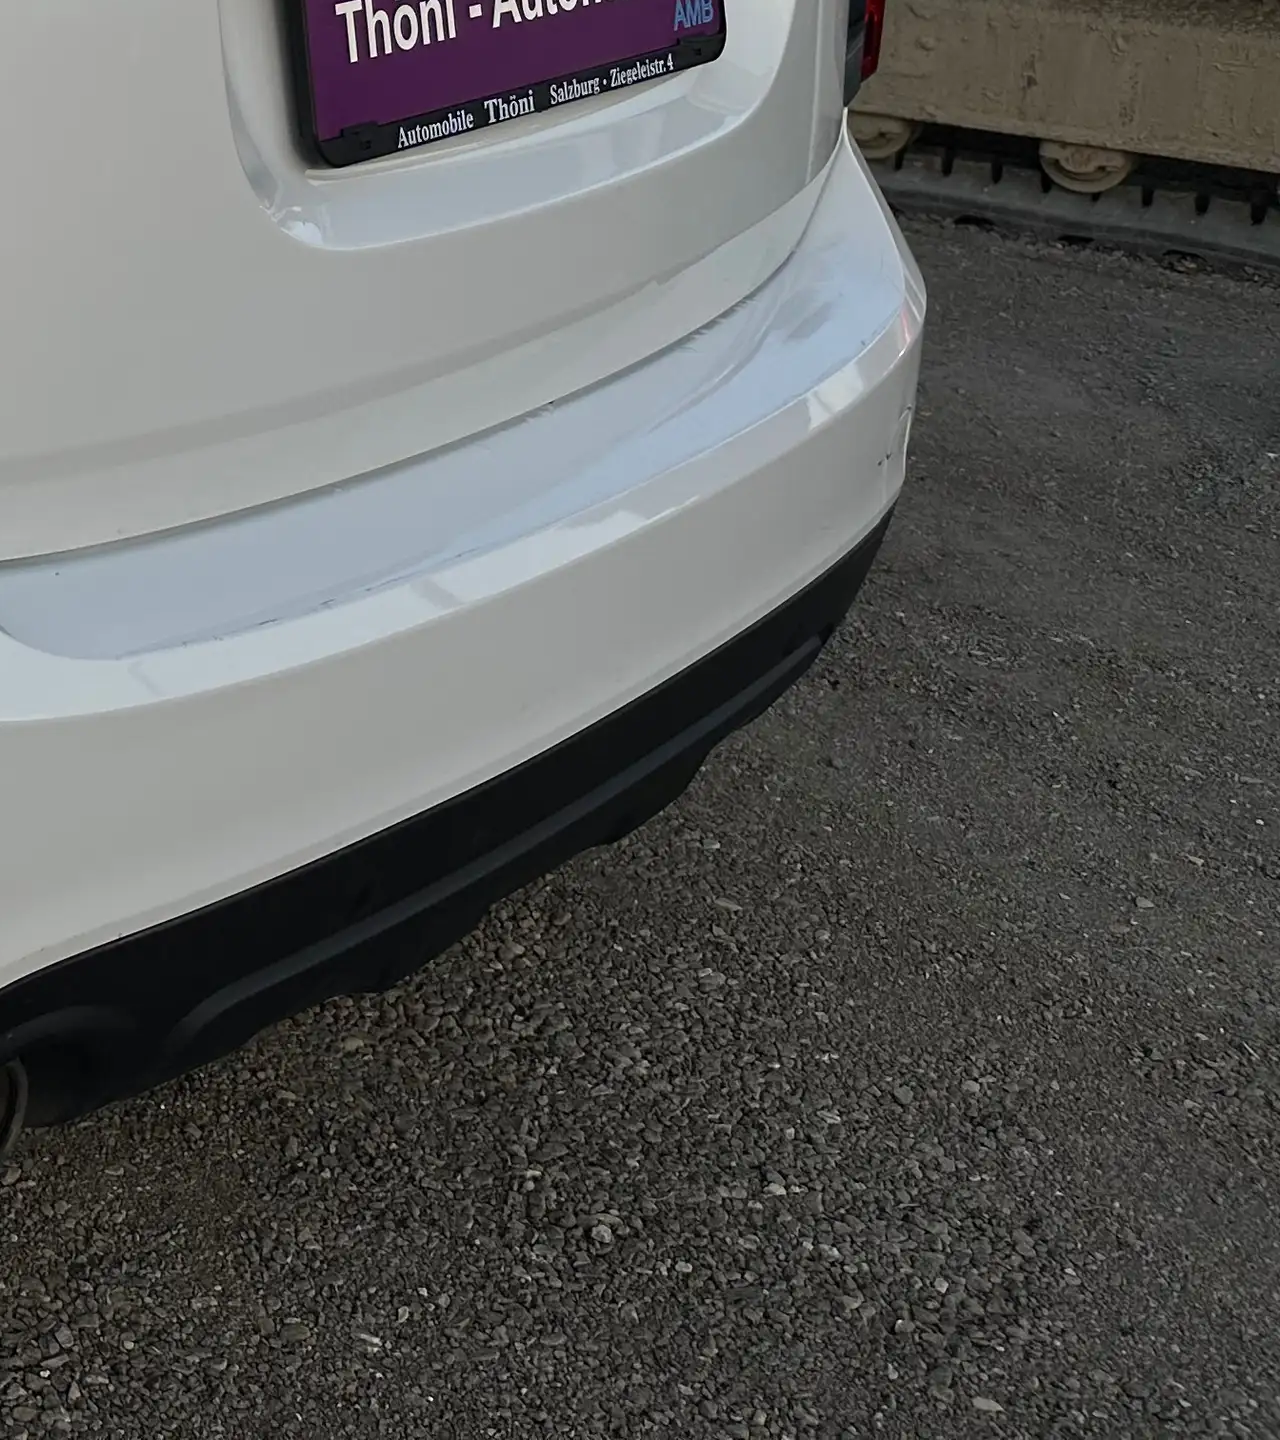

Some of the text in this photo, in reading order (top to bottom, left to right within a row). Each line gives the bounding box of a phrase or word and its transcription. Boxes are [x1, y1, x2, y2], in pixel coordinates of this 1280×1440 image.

[397, 110, 474, 149] Automobile
[484, 89, 535, 124] Thöni
[549, 77, 600, 105] Salzburg
